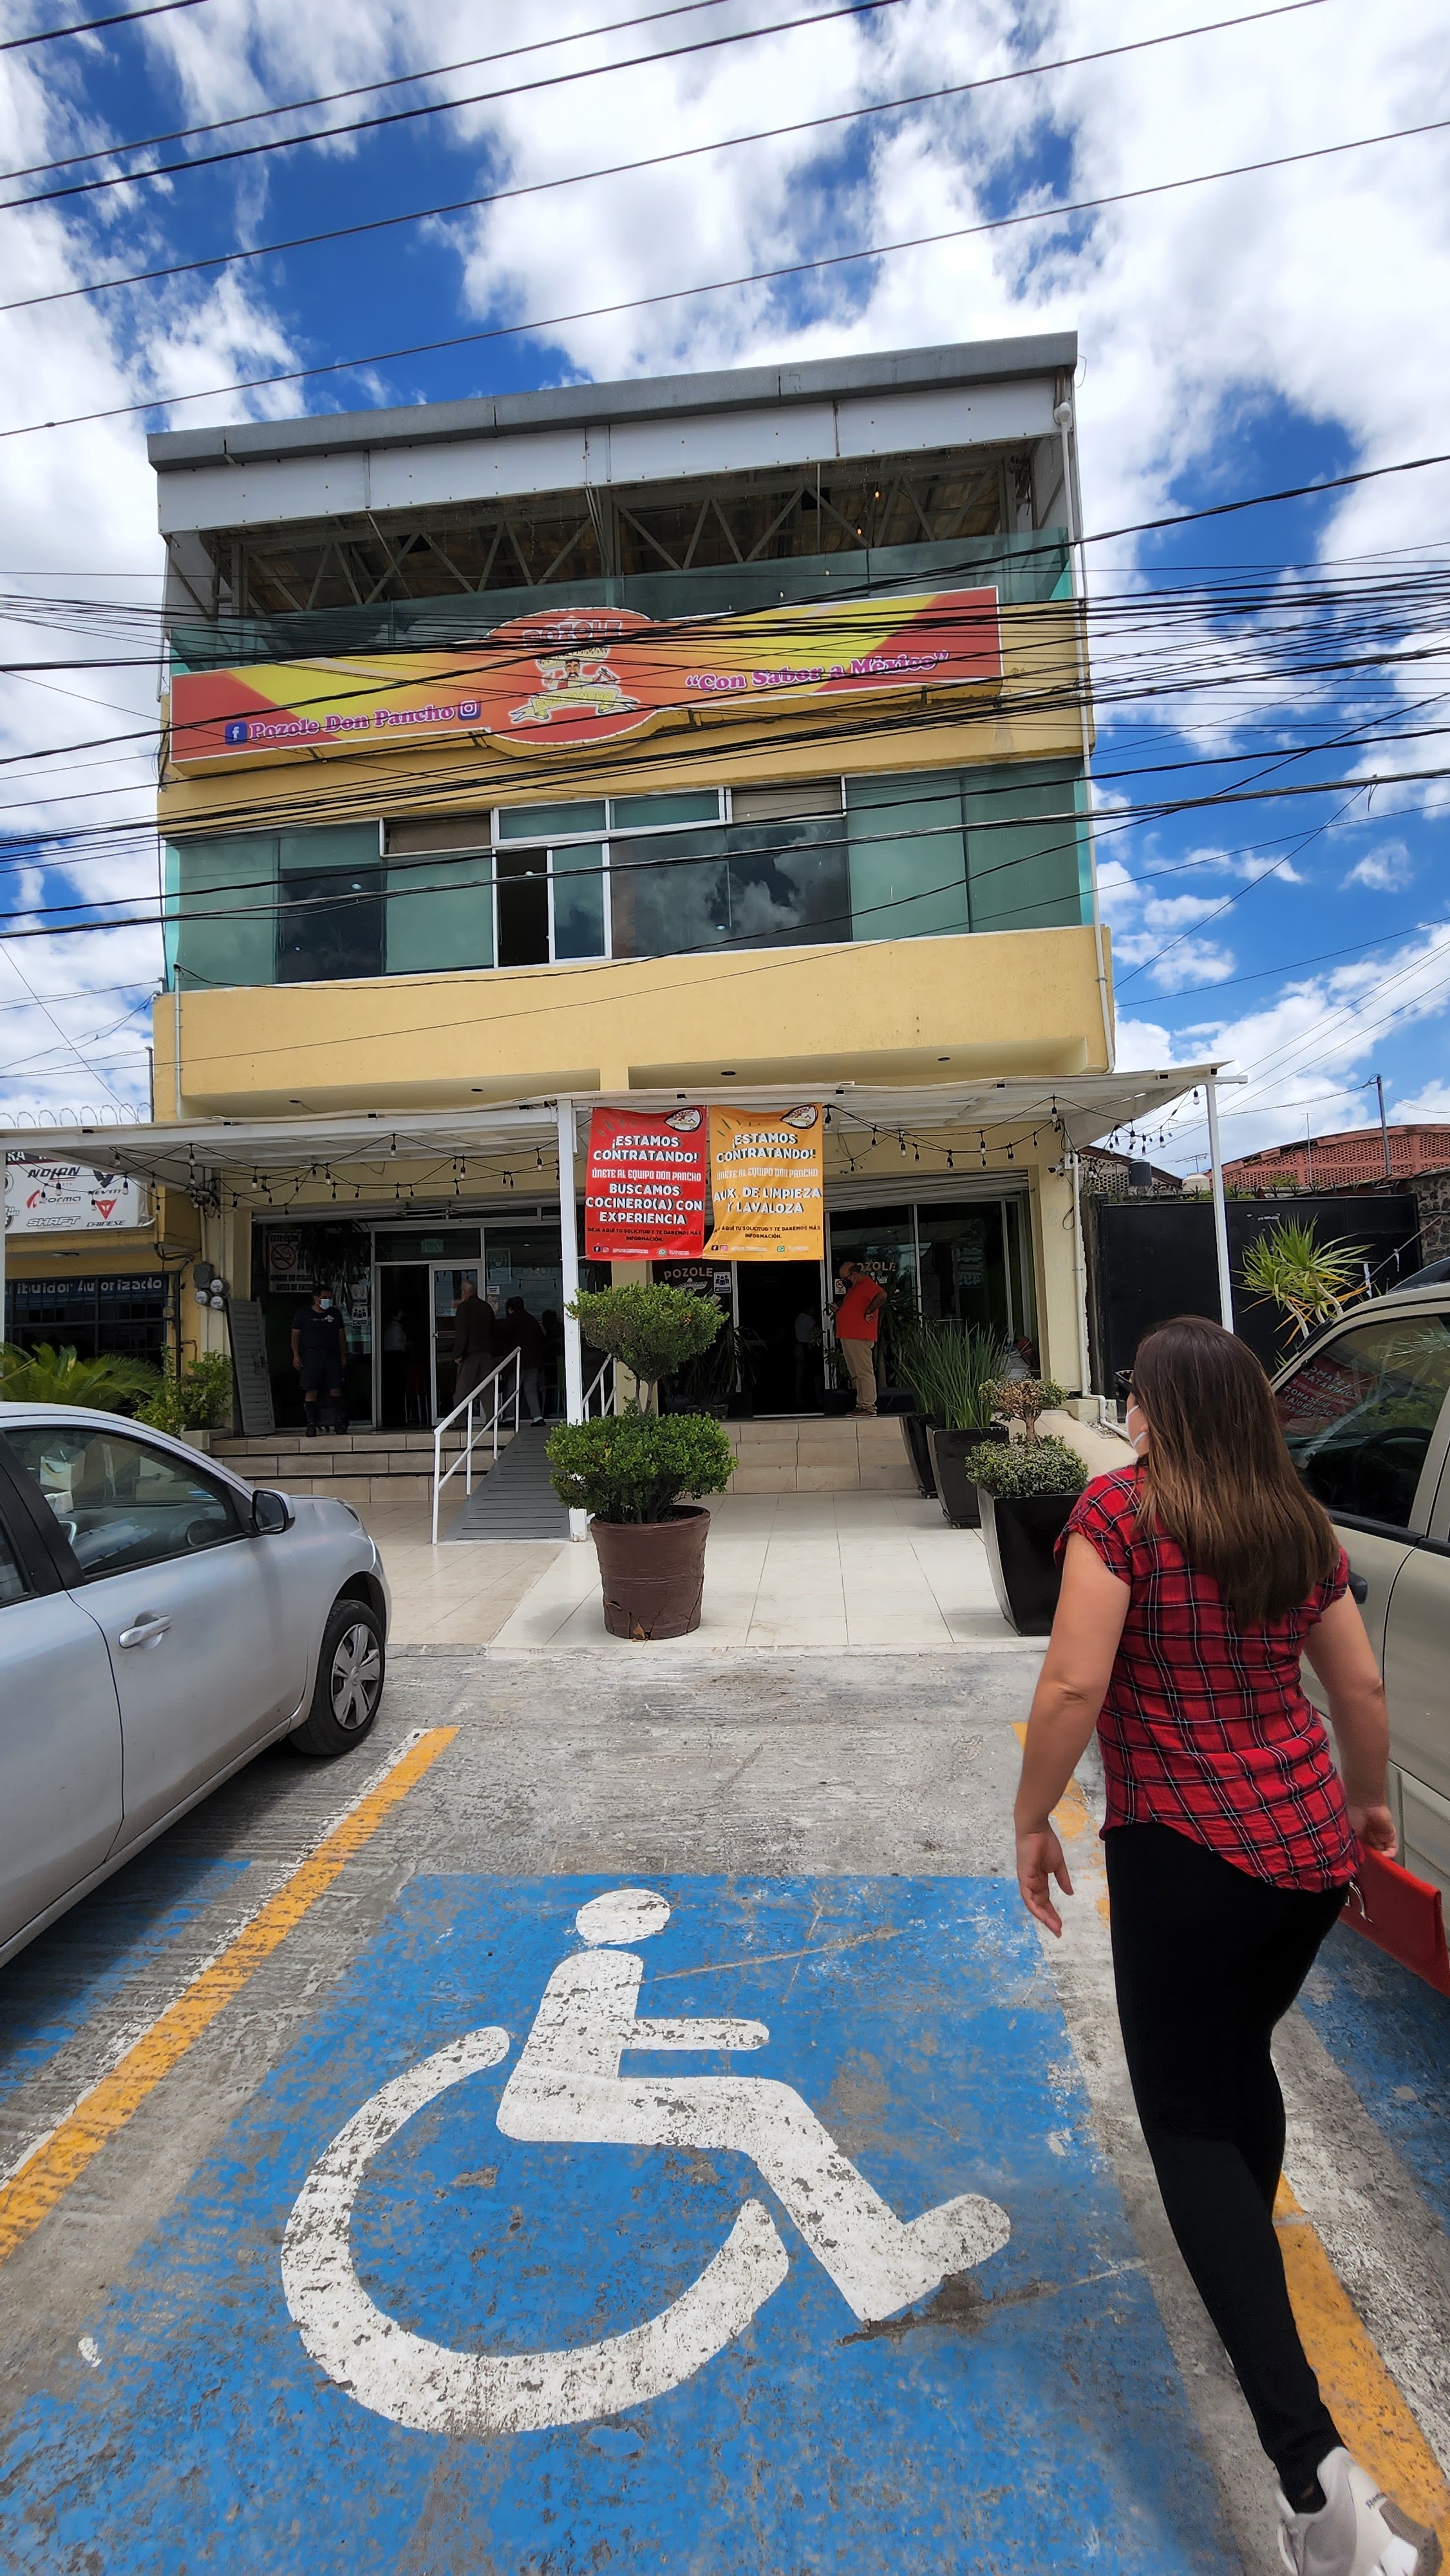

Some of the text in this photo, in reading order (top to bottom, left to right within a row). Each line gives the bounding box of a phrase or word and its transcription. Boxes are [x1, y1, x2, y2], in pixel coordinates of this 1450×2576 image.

[751, 665, 824, 687] Sabor
[829, 664, 845, 679] a
[536, 691, 613, 710] DON PANCHO
[249, 718, 319, 739] Pozole
[323, 714, 370, 732] Don
[373, 704, 454, 727] Pancho
[612, 1135, 681, 1149] ¡ESTAMOS
[732, 1133, 797, 1149] ¡ESTAMOS
[593, 1150, 698, 1163] CONTRATANDO!
[716, 1148, 816, 1164] CONTRATANDO!
[592, 1168, 701, 1182] ÚNETE AL EQUIPO DON PANCHO
[748, 1167, 773, 1178] EQUIPO
[775, 1169, 788, 1178] DON
[789, 1168, 818, 1179] PANCHO
[609, 1184, 681, 1196] BUSCAMOS
[742, 1187, 760, 1198] DE
[762, 1188, 822, 1199] LIMPIEZA
[586, 1197, 704, 1211] COCINERO(A) CON
[727, 1202, 804, 1213] Y LAVALOZA
[26, 1215, 81, 1227] SHAFT
[599, 1212, 687, 1224] EXPERIENCIA
[856, 1261, 896, 1272] OZOLE
[663, 1267, 713, 1281] POZOLE
[77, 1277, 162, 1292] Auorizado
